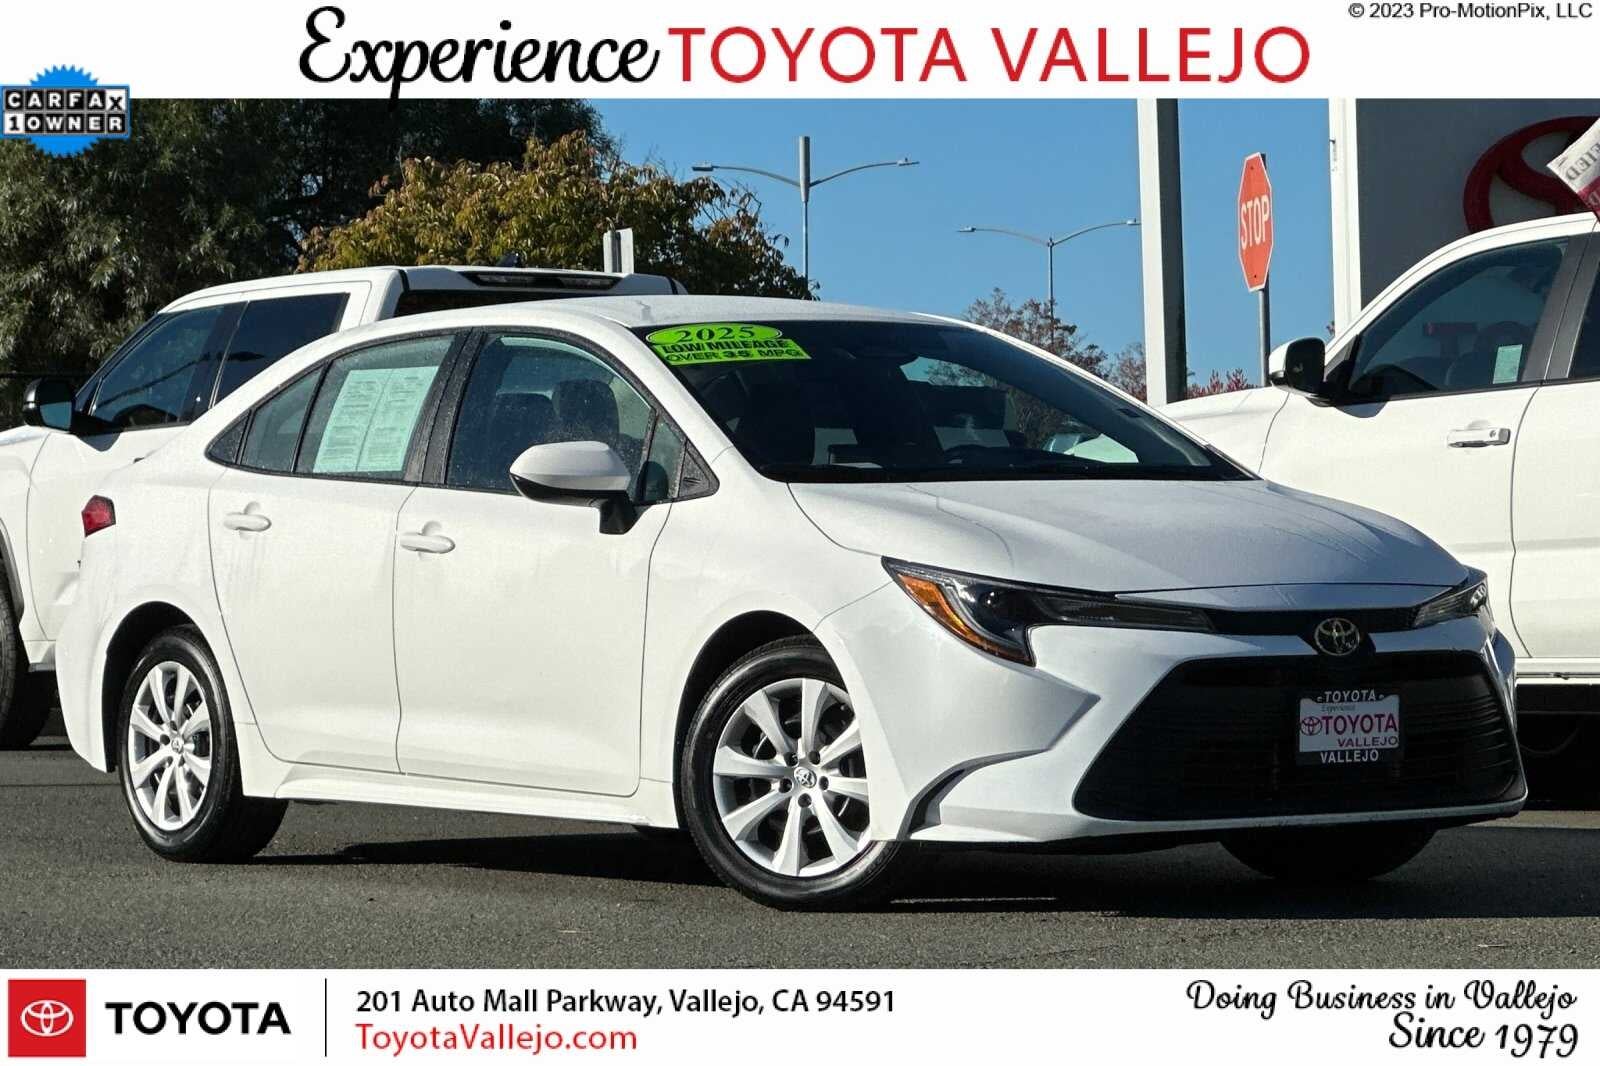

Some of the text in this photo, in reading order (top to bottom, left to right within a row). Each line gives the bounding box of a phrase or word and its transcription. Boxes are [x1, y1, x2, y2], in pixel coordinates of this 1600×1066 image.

[1241, 194, 1270, 251] STOP
[675, 326, 756, 343] 2025
[662, 339, 788, 354] LOW MILEAGE
[666, 351, 719, 362] OVER
[758, 349, 802, 358] MPG
[1324, 689, 1377, 703] TOYOTA
[1321, 713, 1398, 736] TOYOTA
[1338, 736, 1399, 748] VALLEJO
[1320, 750, 1379, 764] VALLEJO
